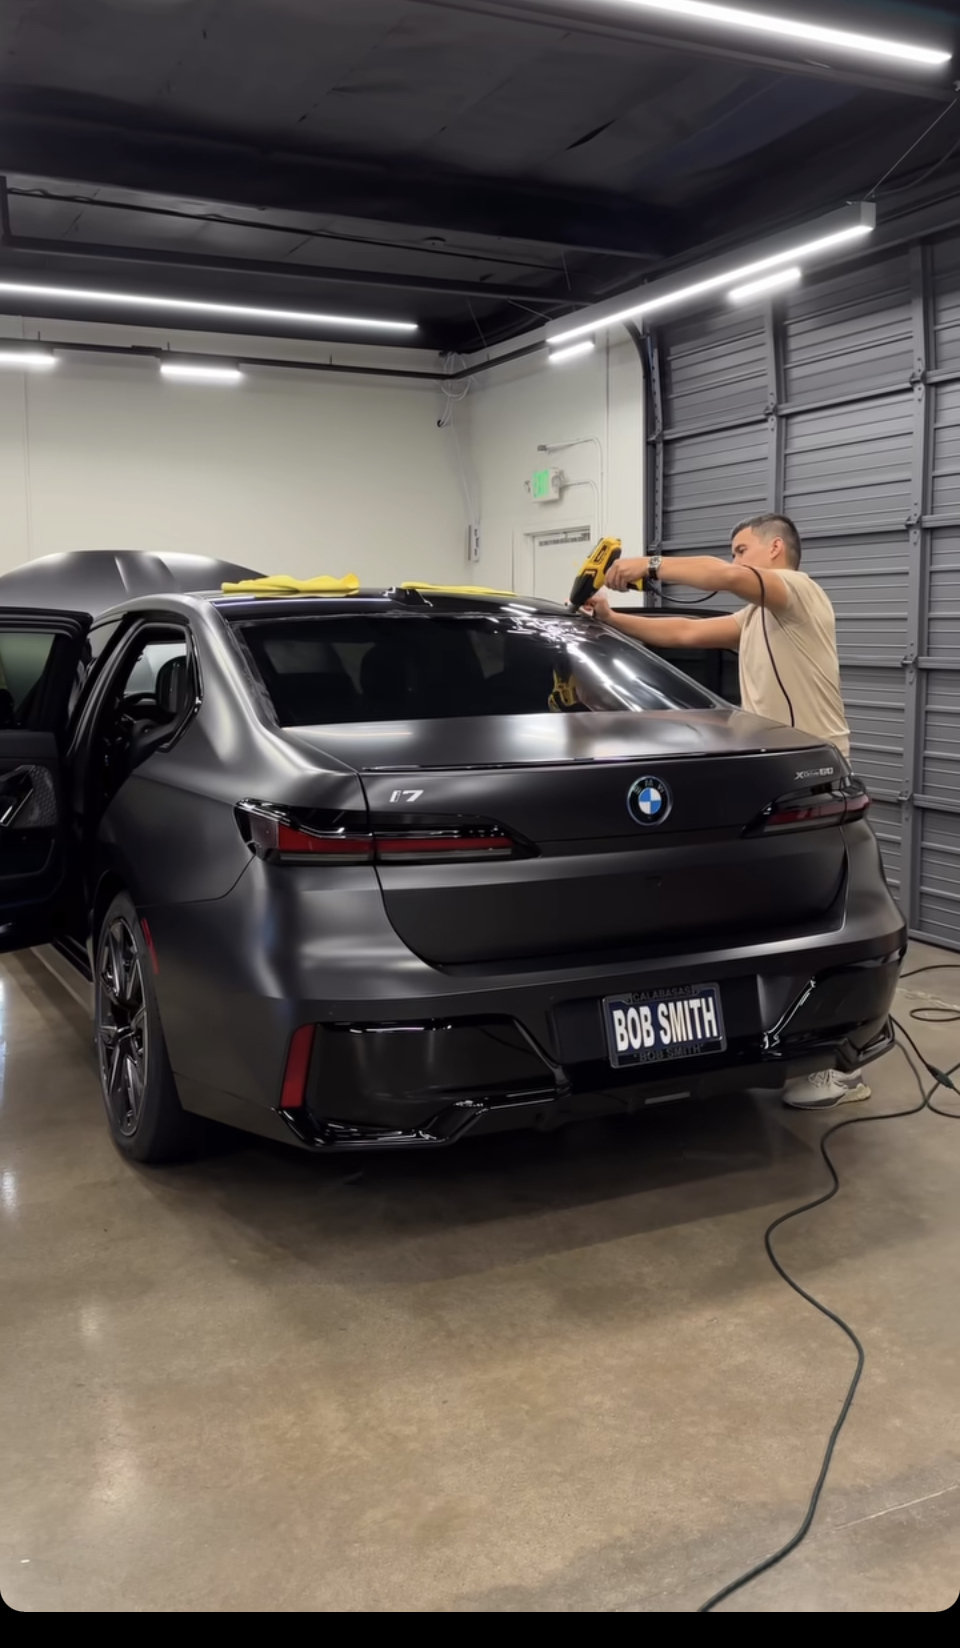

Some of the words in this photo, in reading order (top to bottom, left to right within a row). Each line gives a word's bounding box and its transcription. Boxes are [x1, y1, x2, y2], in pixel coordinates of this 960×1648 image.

[632, 985, 692, 1003] CALABASAS
[612, 1005, 656, 1052] BOB
[657, 996, 718, 1045] SMITH
[639, 1049, 665, 1062] BOB
[667, 1044, 701, 1059] SMITH
